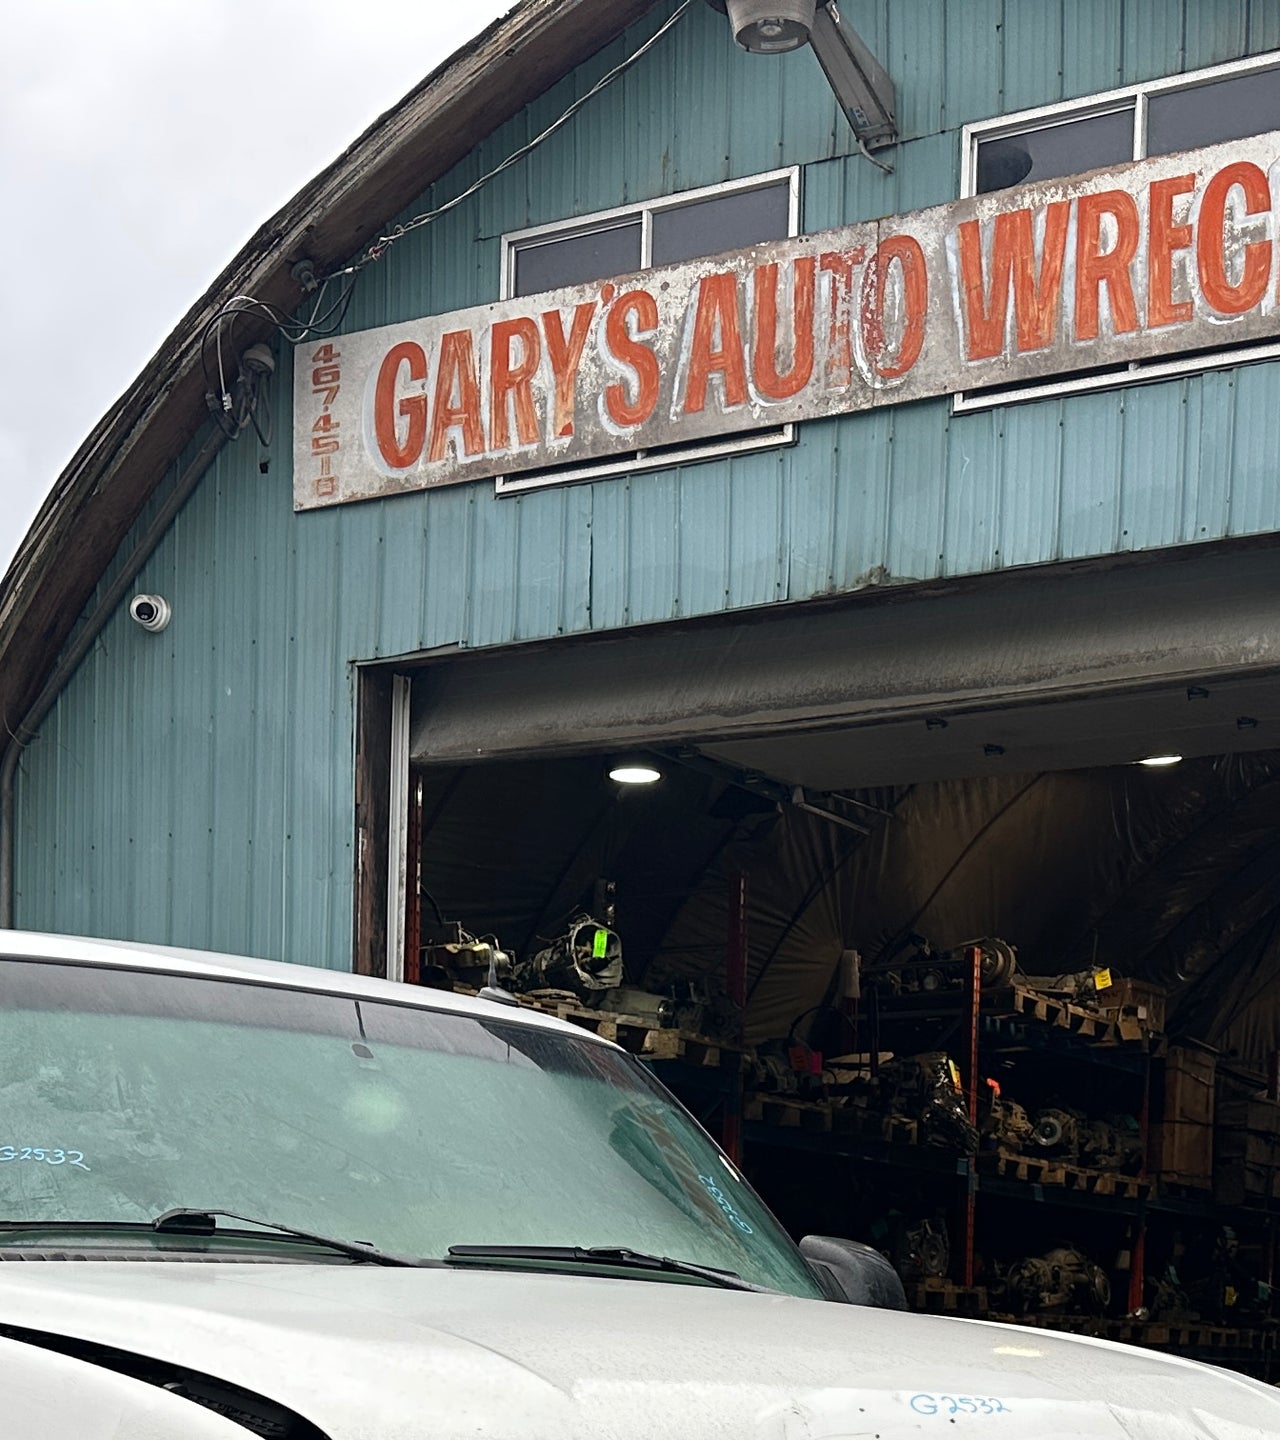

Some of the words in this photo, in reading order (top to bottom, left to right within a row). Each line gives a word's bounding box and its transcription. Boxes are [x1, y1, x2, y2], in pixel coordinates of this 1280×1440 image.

[373, 283, 660, 468] GARY'S
[682, 233, 929, 414] AUTO
[910, 1394, 1013, 1415] G2532
